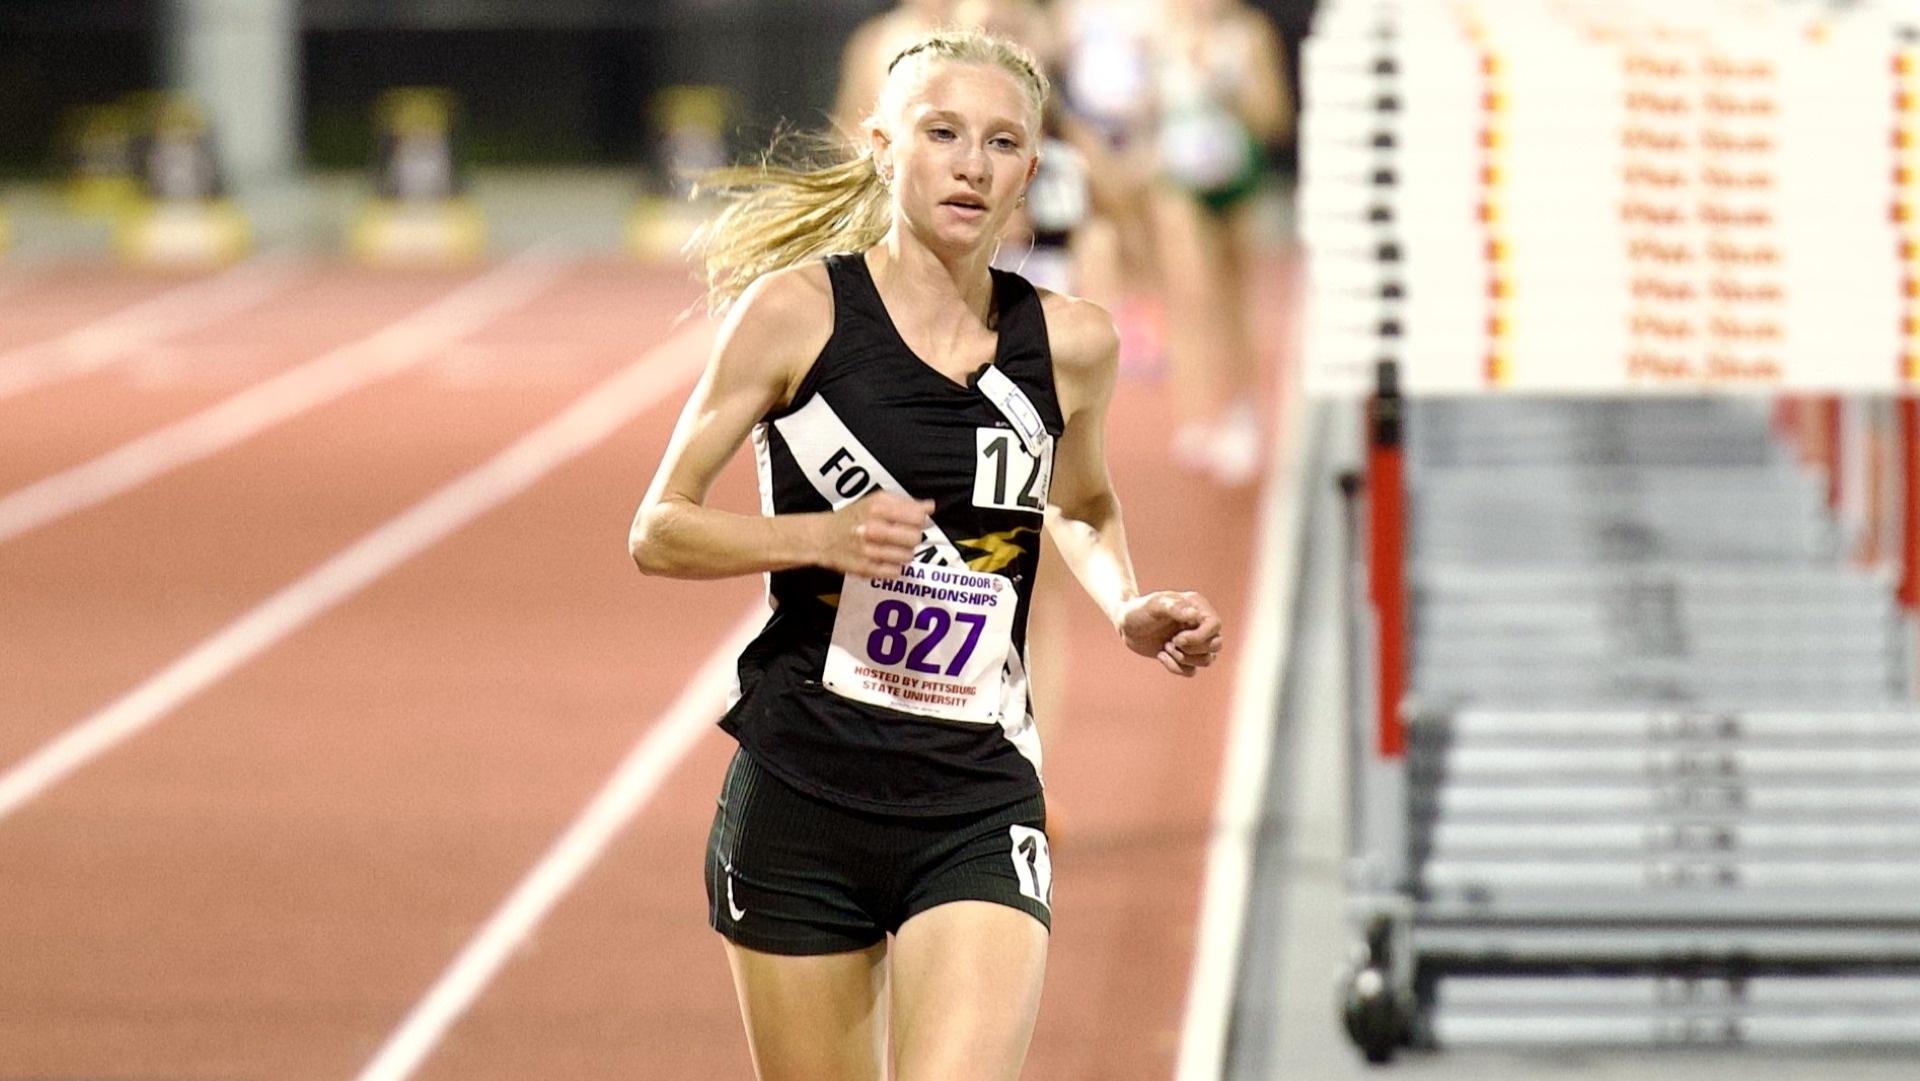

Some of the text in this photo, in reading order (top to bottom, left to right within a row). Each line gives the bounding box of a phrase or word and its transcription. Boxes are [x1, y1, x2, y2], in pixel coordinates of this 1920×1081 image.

[900, 565, 991, 588] IAA OUTDOOR
[870, 578, 998, 607] CHAMPIONSHIPS
[866, 599, 987, 677] 827
[854, 666, 976, 696] HOSTED BY PITTSBURG
[862, 680, 901, 697] STATE
[903, 690, 967, 708] UNIVERSITY
